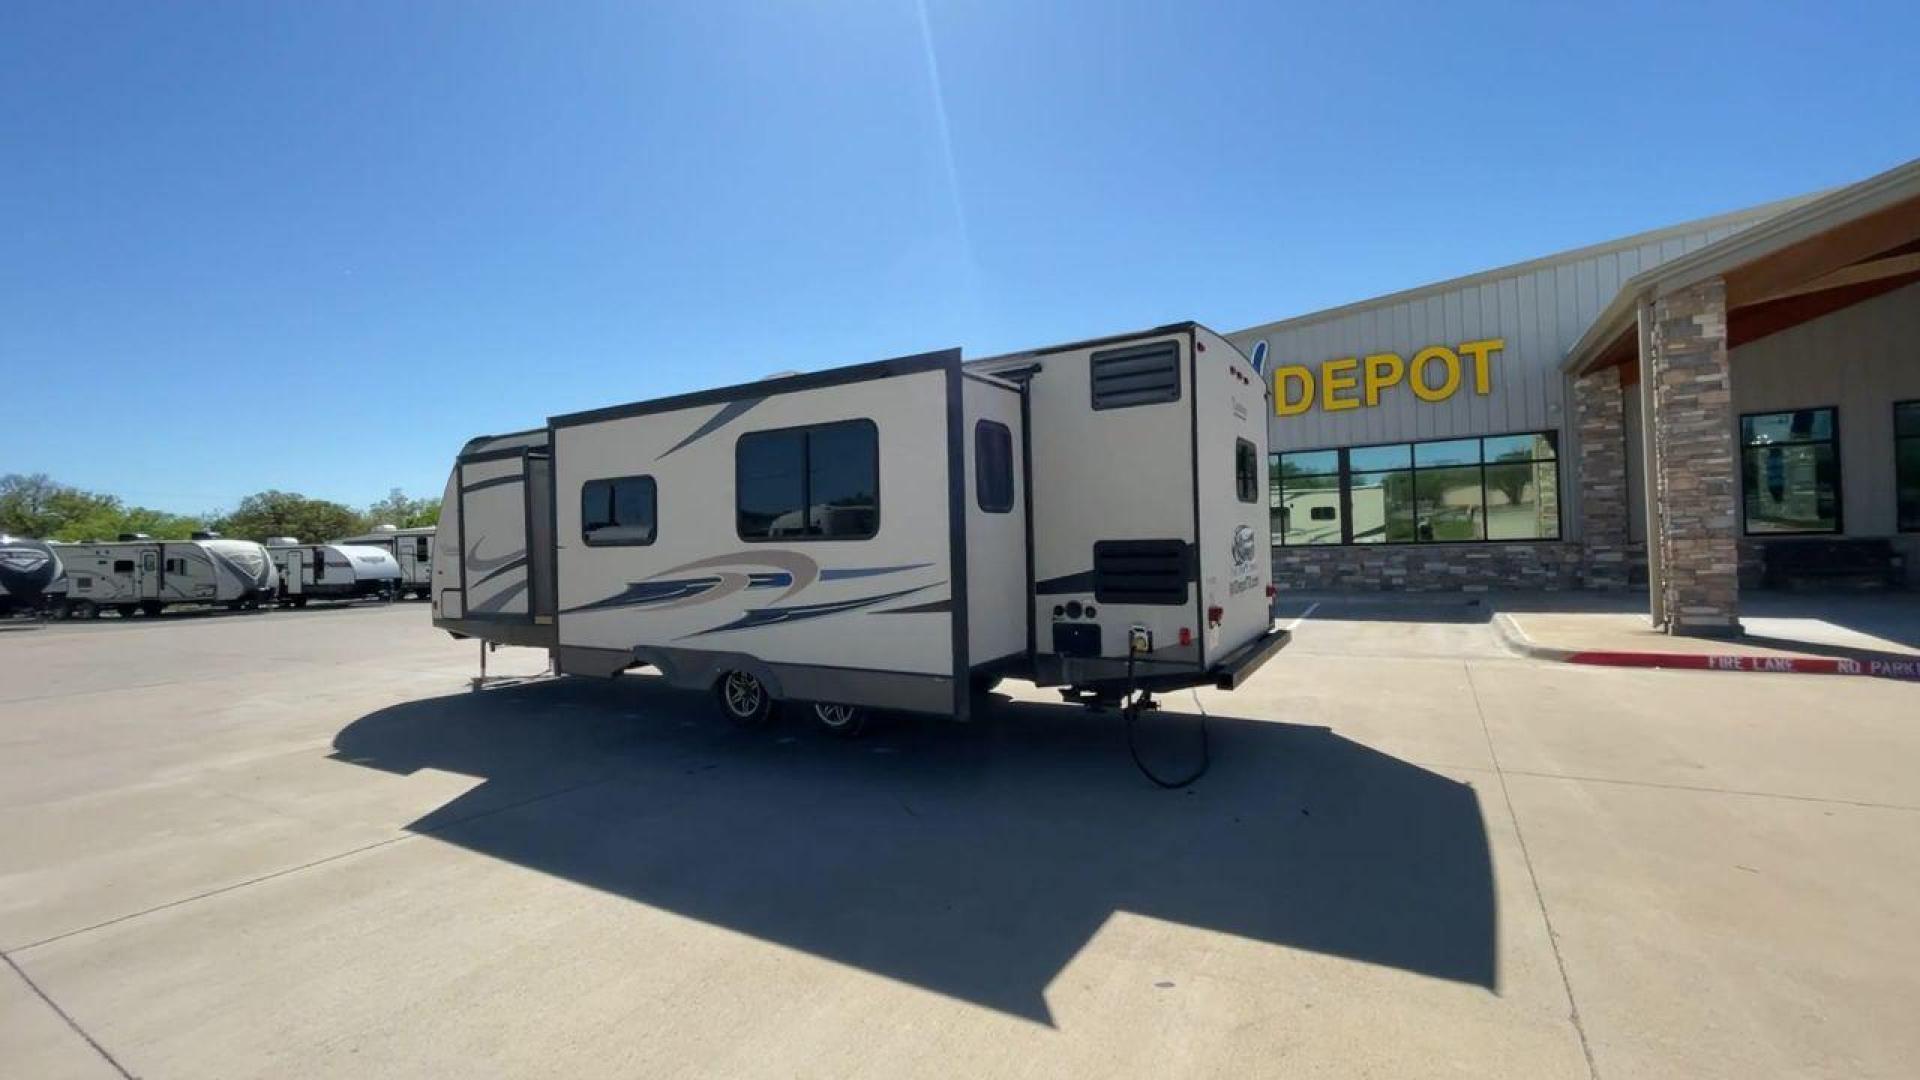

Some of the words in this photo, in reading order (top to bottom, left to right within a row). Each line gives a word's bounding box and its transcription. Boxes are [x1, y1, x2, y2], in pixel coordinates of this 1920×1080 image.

[1273, 338, 1505, 416] DEPOT
[1707, 656, 1743, 671] FIRE
[1752, 657, 1794, 672] LANE
[1837, 659, 1861, 673] NO
